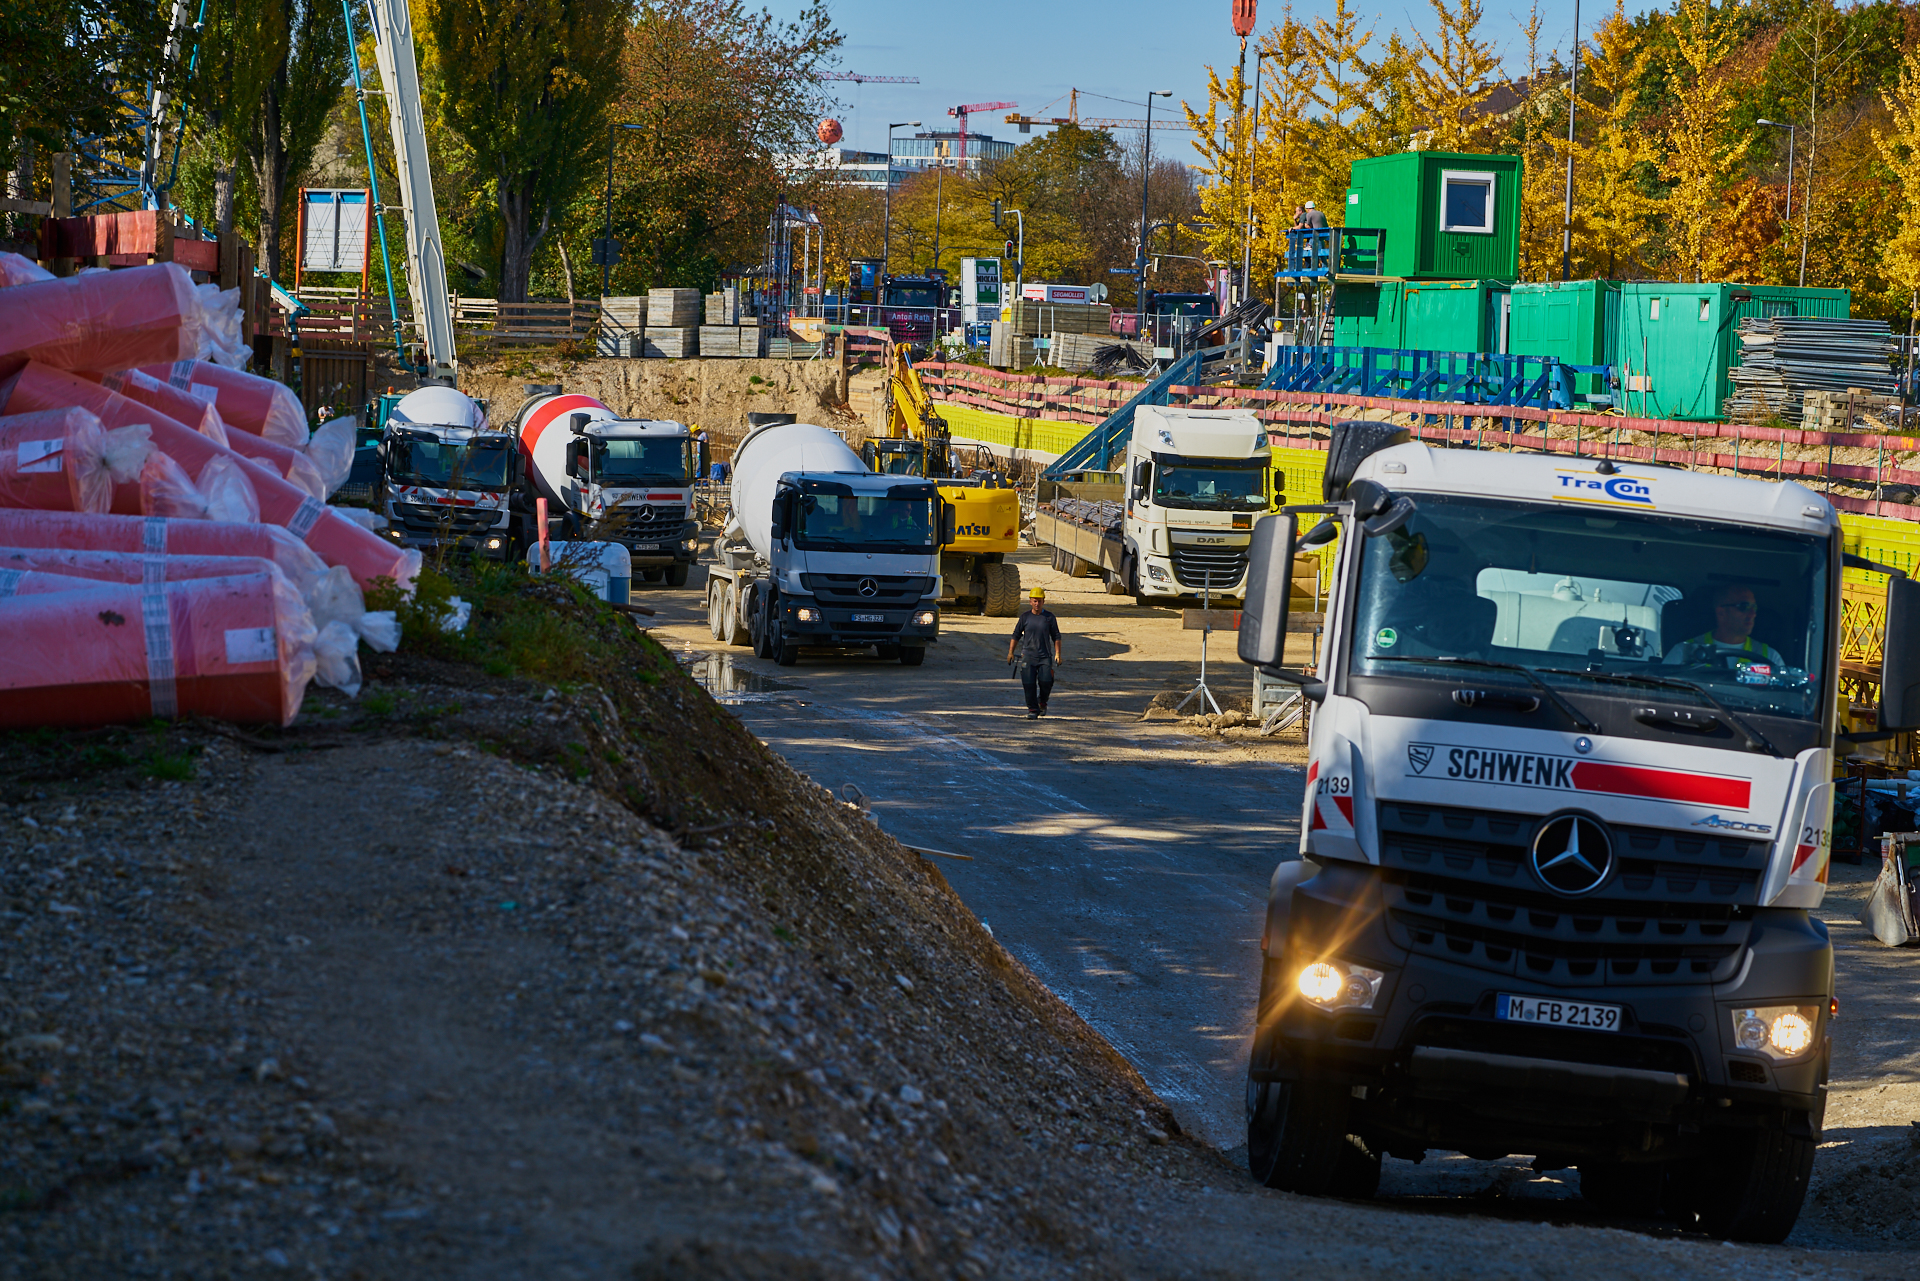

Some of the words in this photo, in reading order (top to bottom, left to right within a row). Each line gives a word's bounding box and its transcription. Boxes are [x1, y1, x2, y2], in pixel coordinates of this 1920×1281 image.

[1557, 475, 1653, 504] TraCon
[957, 523, 990, 535] ATSU
[1447, 748, 1573, 789] SCHWENK
[1317, 776, 1350, 795] 2139
[1510, 999, 1524, 1019] M
[1536, 1002, 1563, 1022] FB
[1566, 1005, 1618, 1029] 2139
